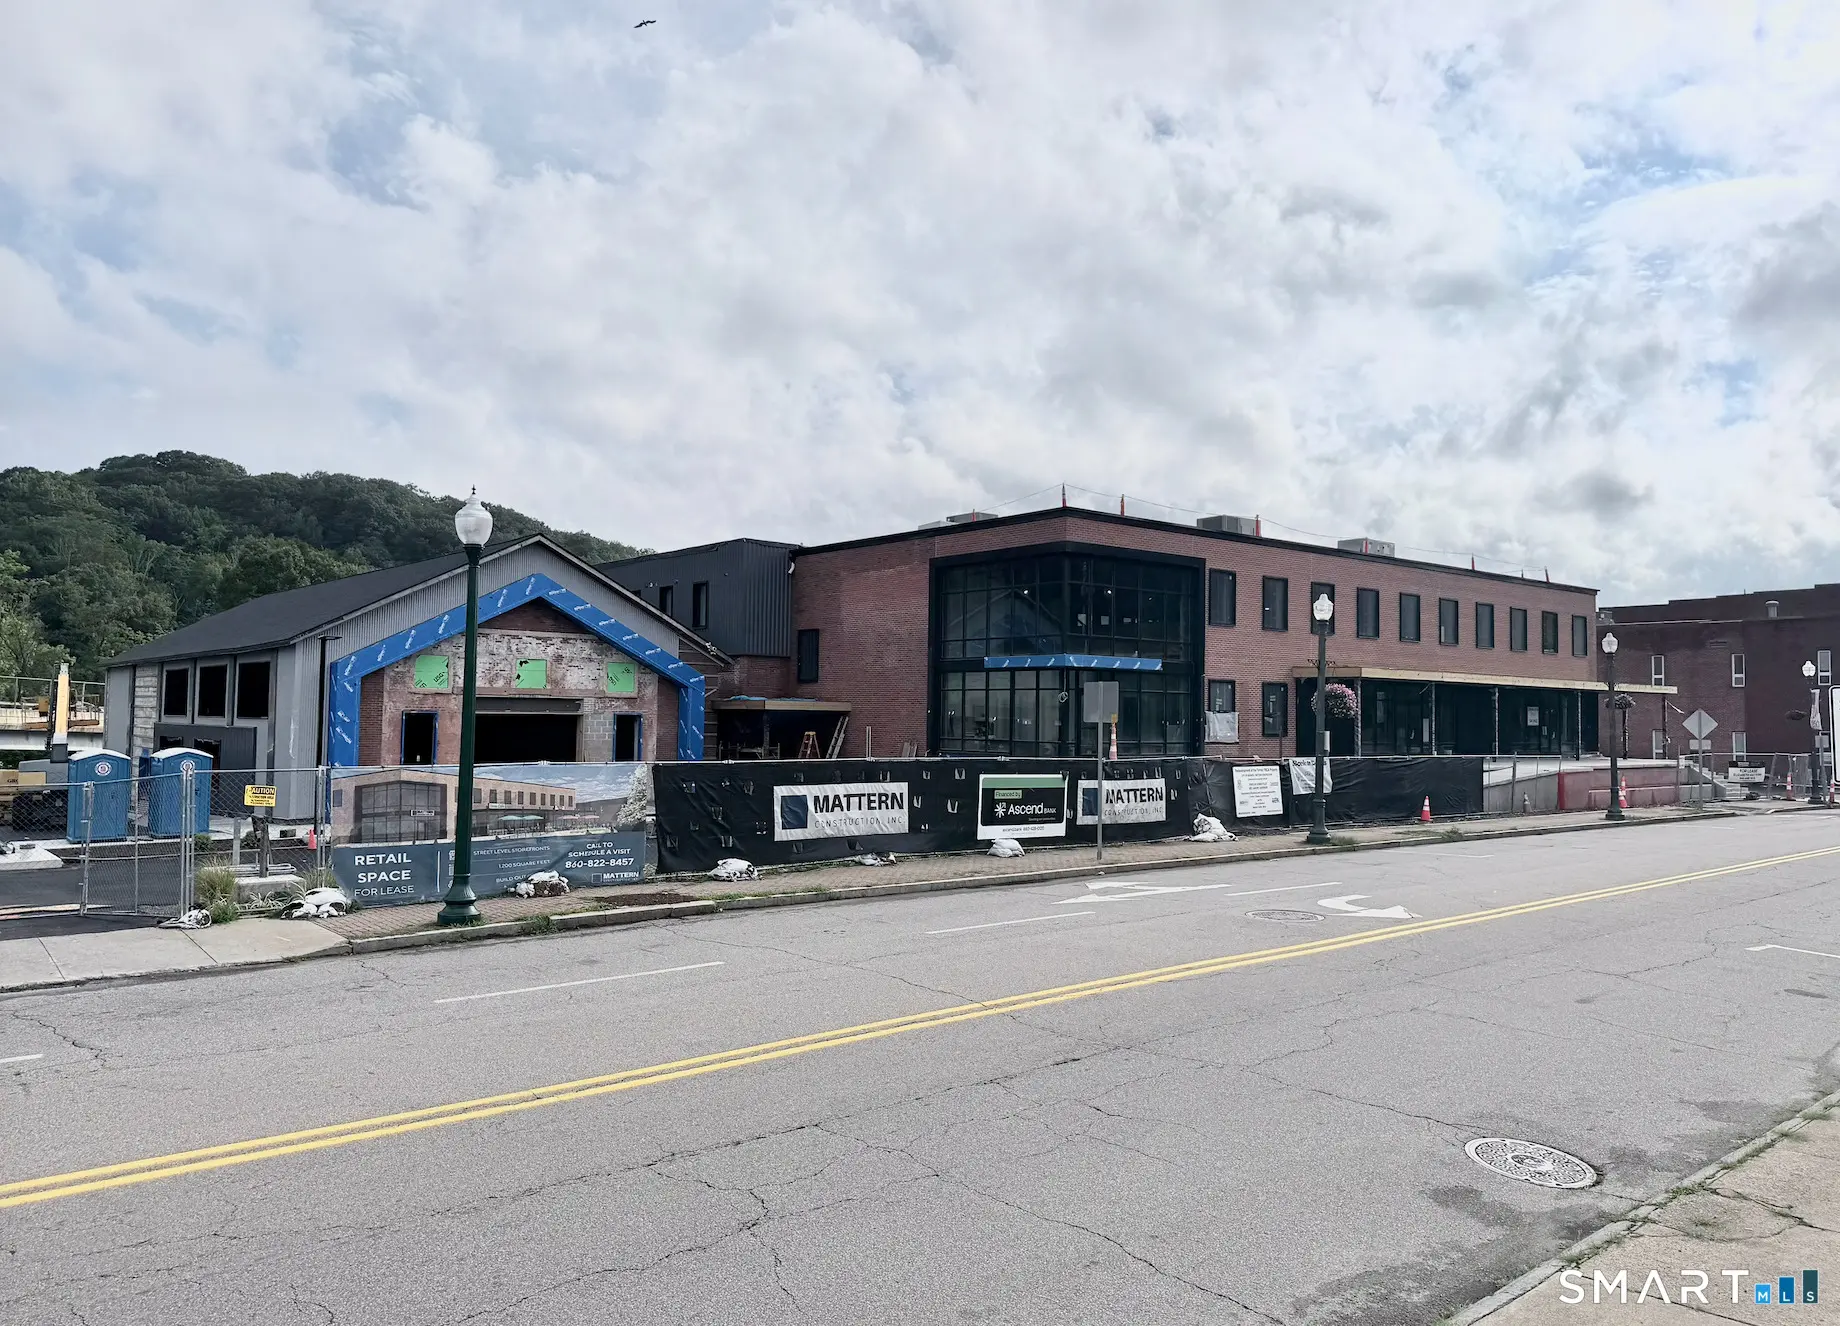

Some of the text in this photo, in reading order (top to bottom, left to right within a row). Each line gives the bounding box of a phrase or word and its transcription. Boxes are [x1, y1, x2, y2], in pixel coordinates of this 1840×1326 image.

[1105, 787, 1164, 804] MATTERN
[813, 792, 904, 814] MATTERN
[1007, 802, 1044, 815] Ascend
[511, 845, 551, 853] STOREFRONTS
[354, 852, 412, 866] RETAIL
[565, 857, 635, 869] 860-822-8457
[357, 869, 412, 884] SPACE
[603, 871, 639, 879] MATTERN
[354, 885, 415, 897] FOR LEASE
